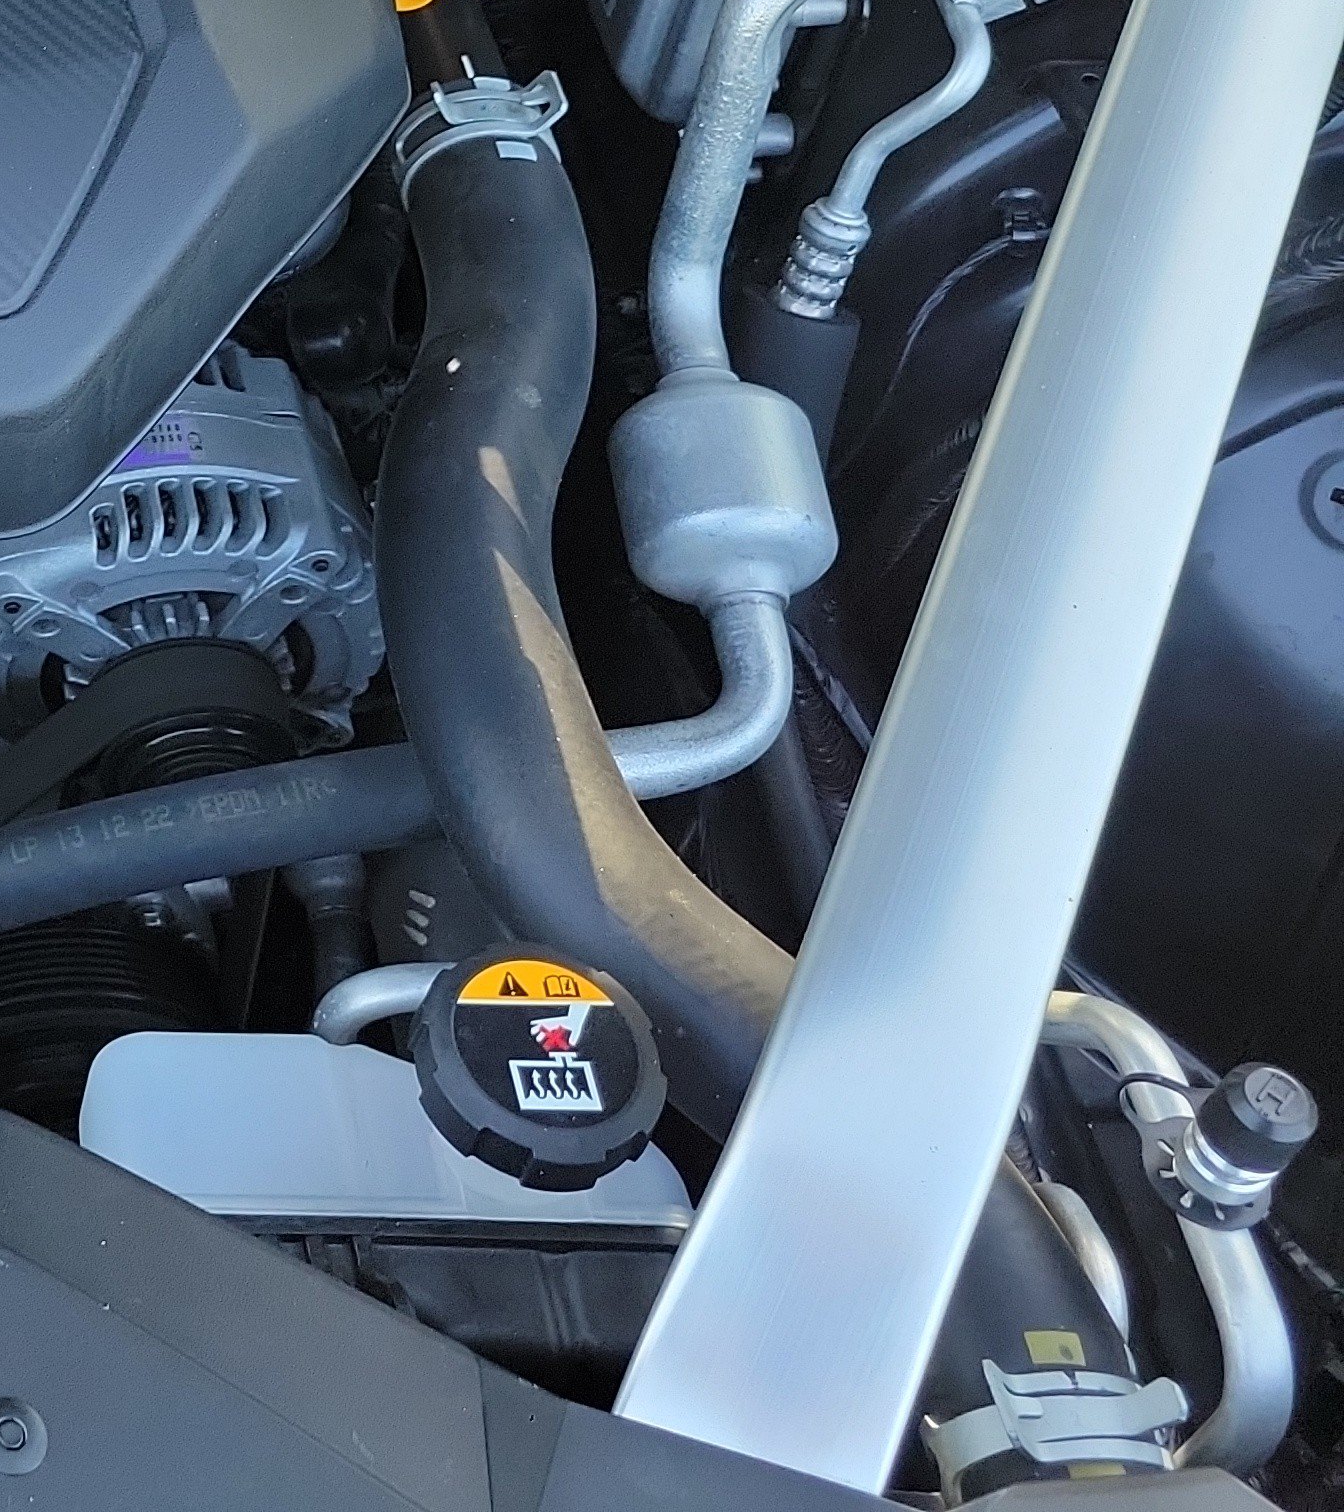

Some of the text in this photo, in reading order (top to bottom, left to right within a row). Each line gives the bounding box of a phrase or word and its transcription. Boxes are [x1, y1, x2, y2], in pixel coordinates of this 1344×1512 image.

[55, 824, 86, 852] 13
[99, 814, 131, 841] 12
[141, 803, 175, 832] 22
